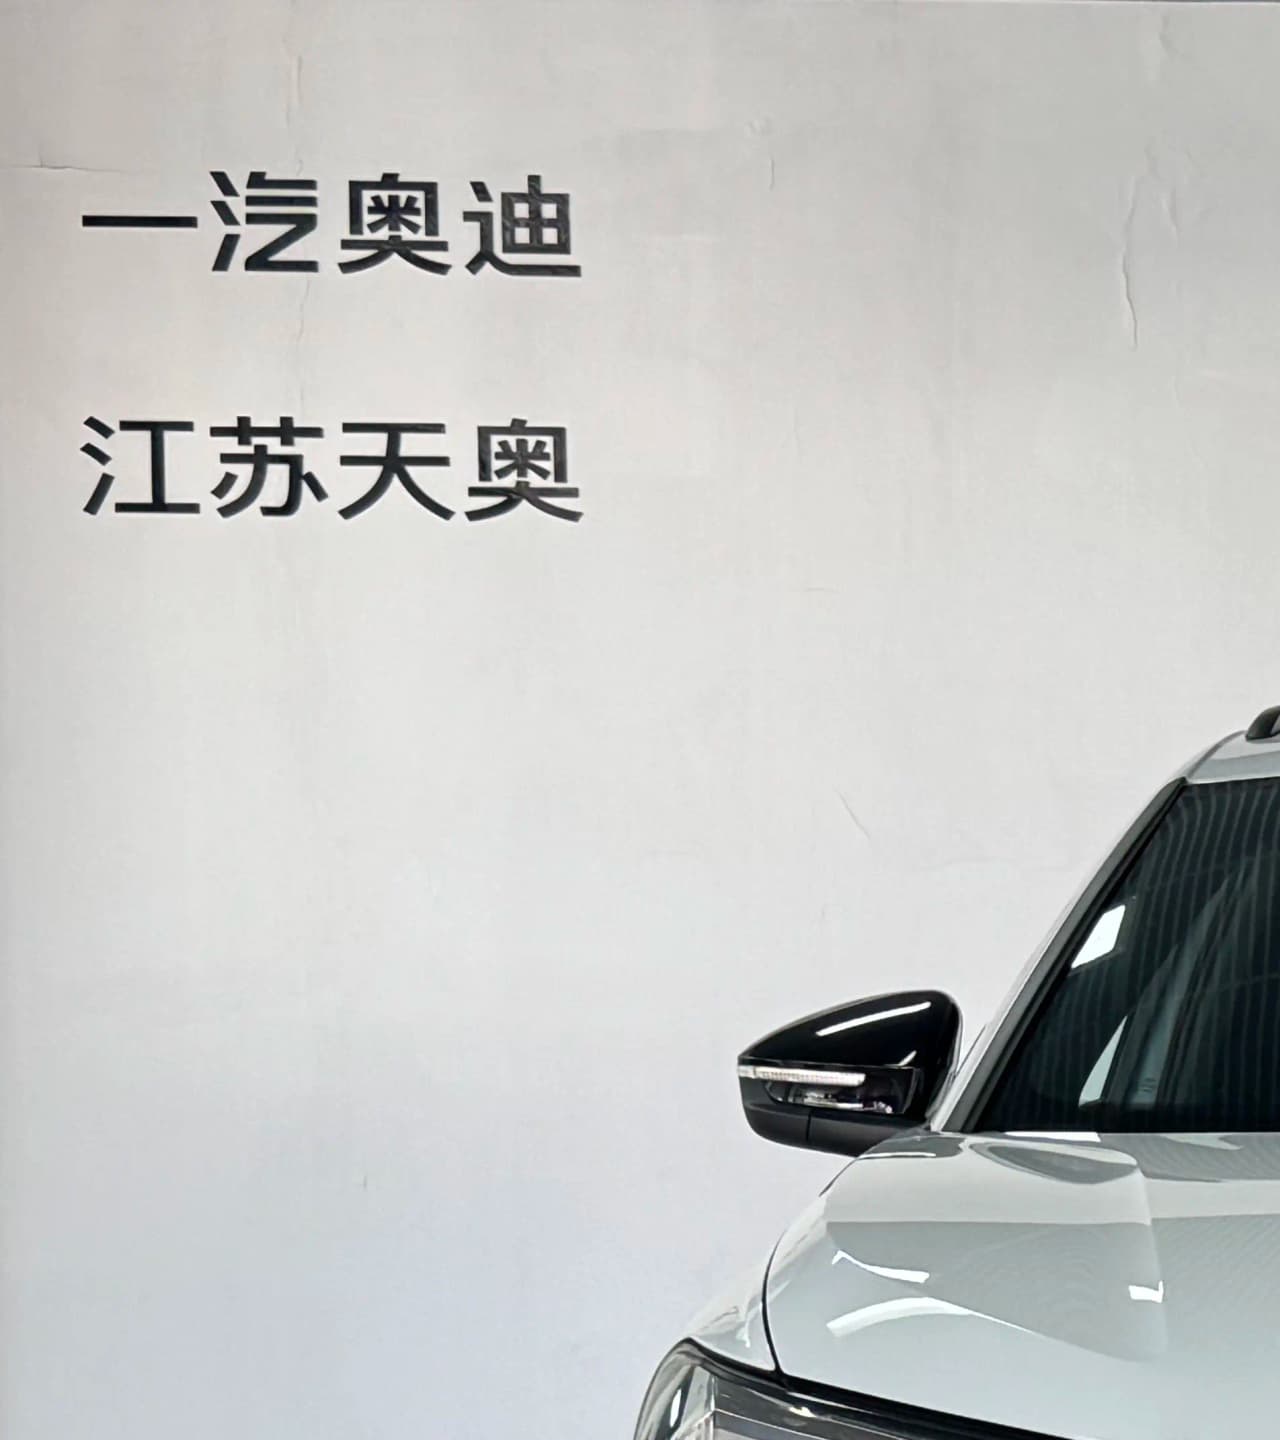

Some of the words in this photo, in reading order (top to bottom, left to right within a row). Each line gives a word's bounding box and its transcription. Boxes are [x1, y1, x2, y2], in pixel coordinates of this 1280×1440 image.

[81, 171, 582, 278] 一汽奥迪
[80, 415, 584, 522] 江苏天奥
